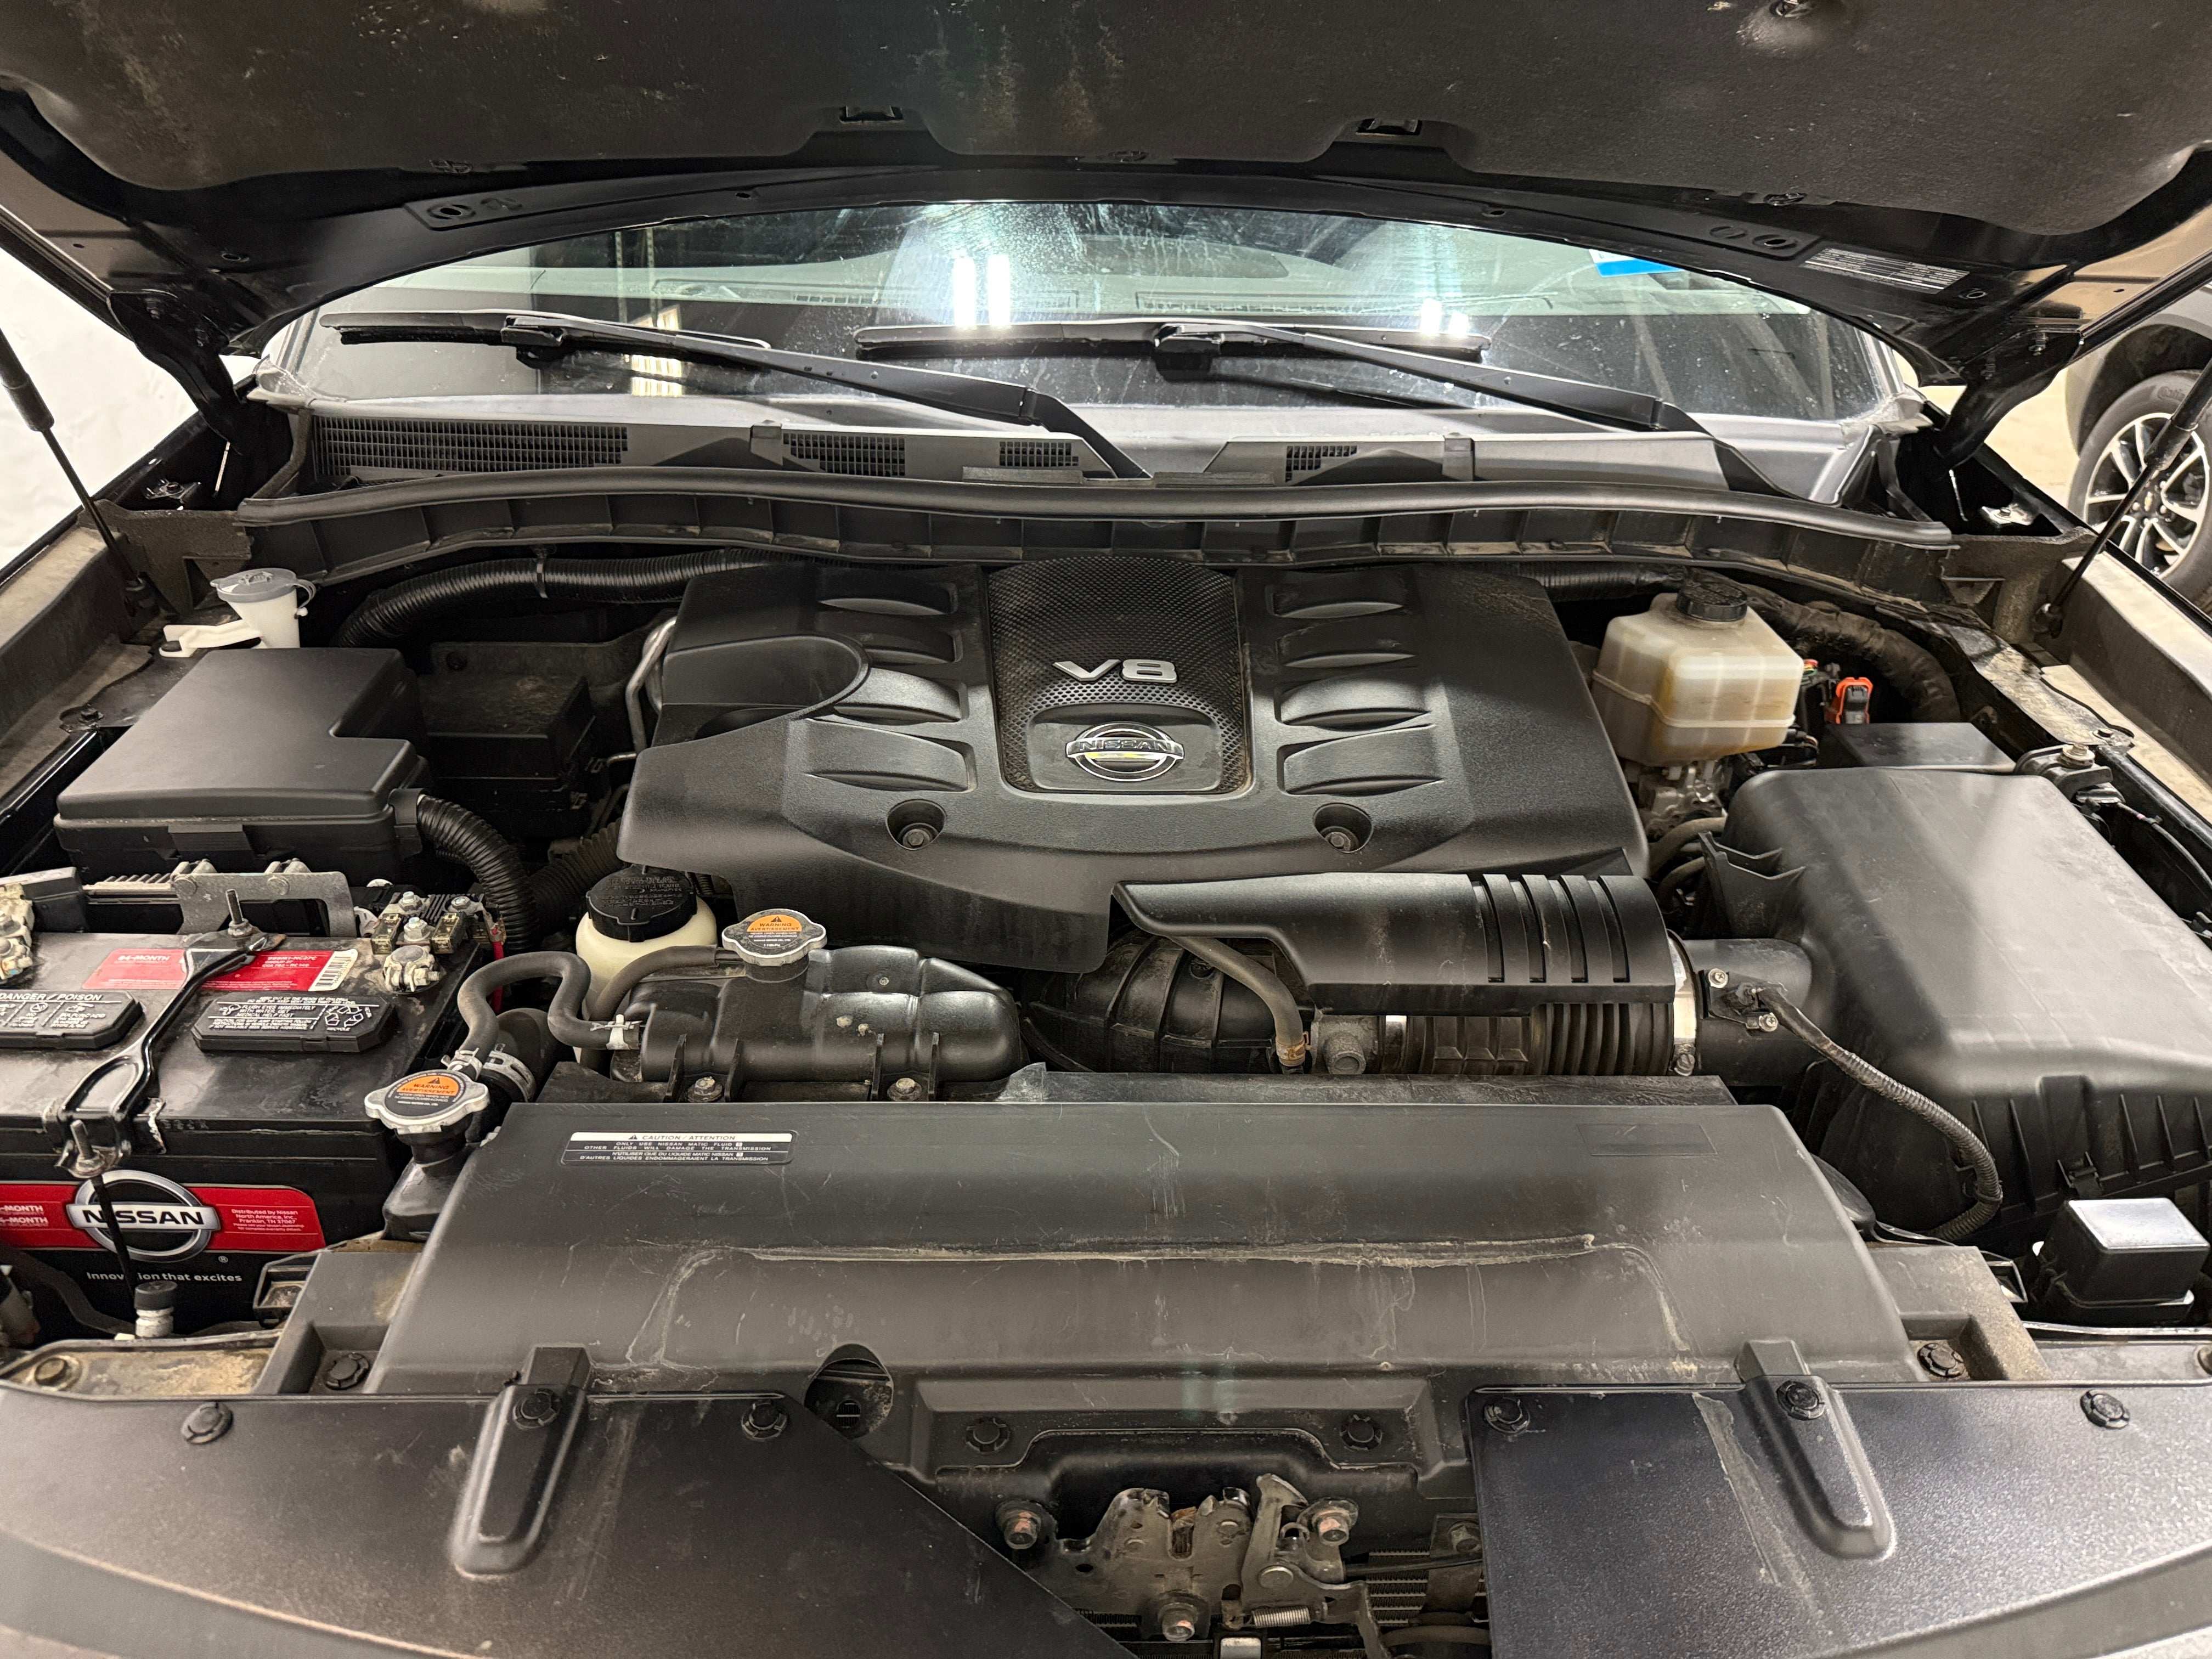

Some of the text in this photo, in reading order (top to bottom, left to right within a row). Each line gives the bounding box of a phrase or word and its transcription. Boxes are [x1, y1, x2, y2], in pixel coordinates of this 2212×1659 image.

[1052, 658, 1179, 683] V8
[1079, 739, 1172, 751] NISSAN
[82, 1210, 205, 1225] NSSAN
[86, 1271, 242, 1282] Innovion that excites
